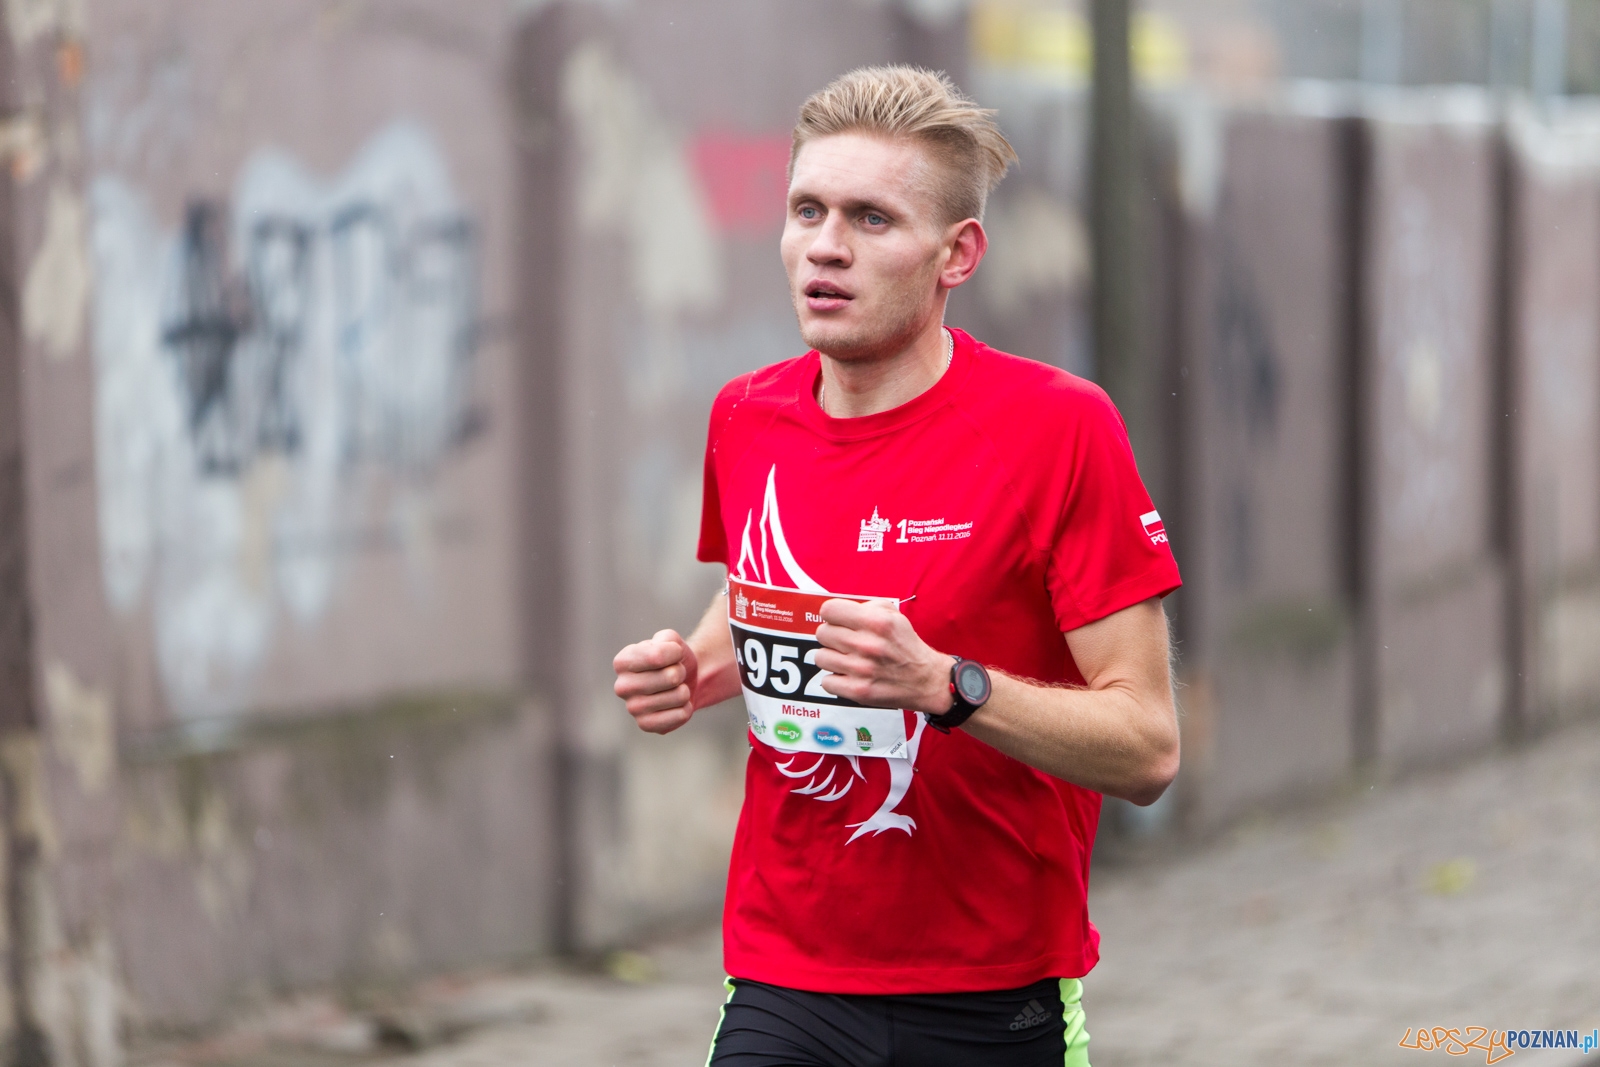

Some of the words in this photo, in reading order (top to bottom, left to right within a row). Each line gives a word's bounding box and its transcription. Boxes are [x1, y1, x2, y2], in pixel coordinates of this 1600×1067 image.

[907, 526, 923, 534] Bieg
[908, 518, 944, 526] Poznański
[896, 519, 909, 543] 1
[744, 638, 838, 699] 952
[782, 704, 821, 719] Michał
[1009, 1011, 1052, 1031] adidas
